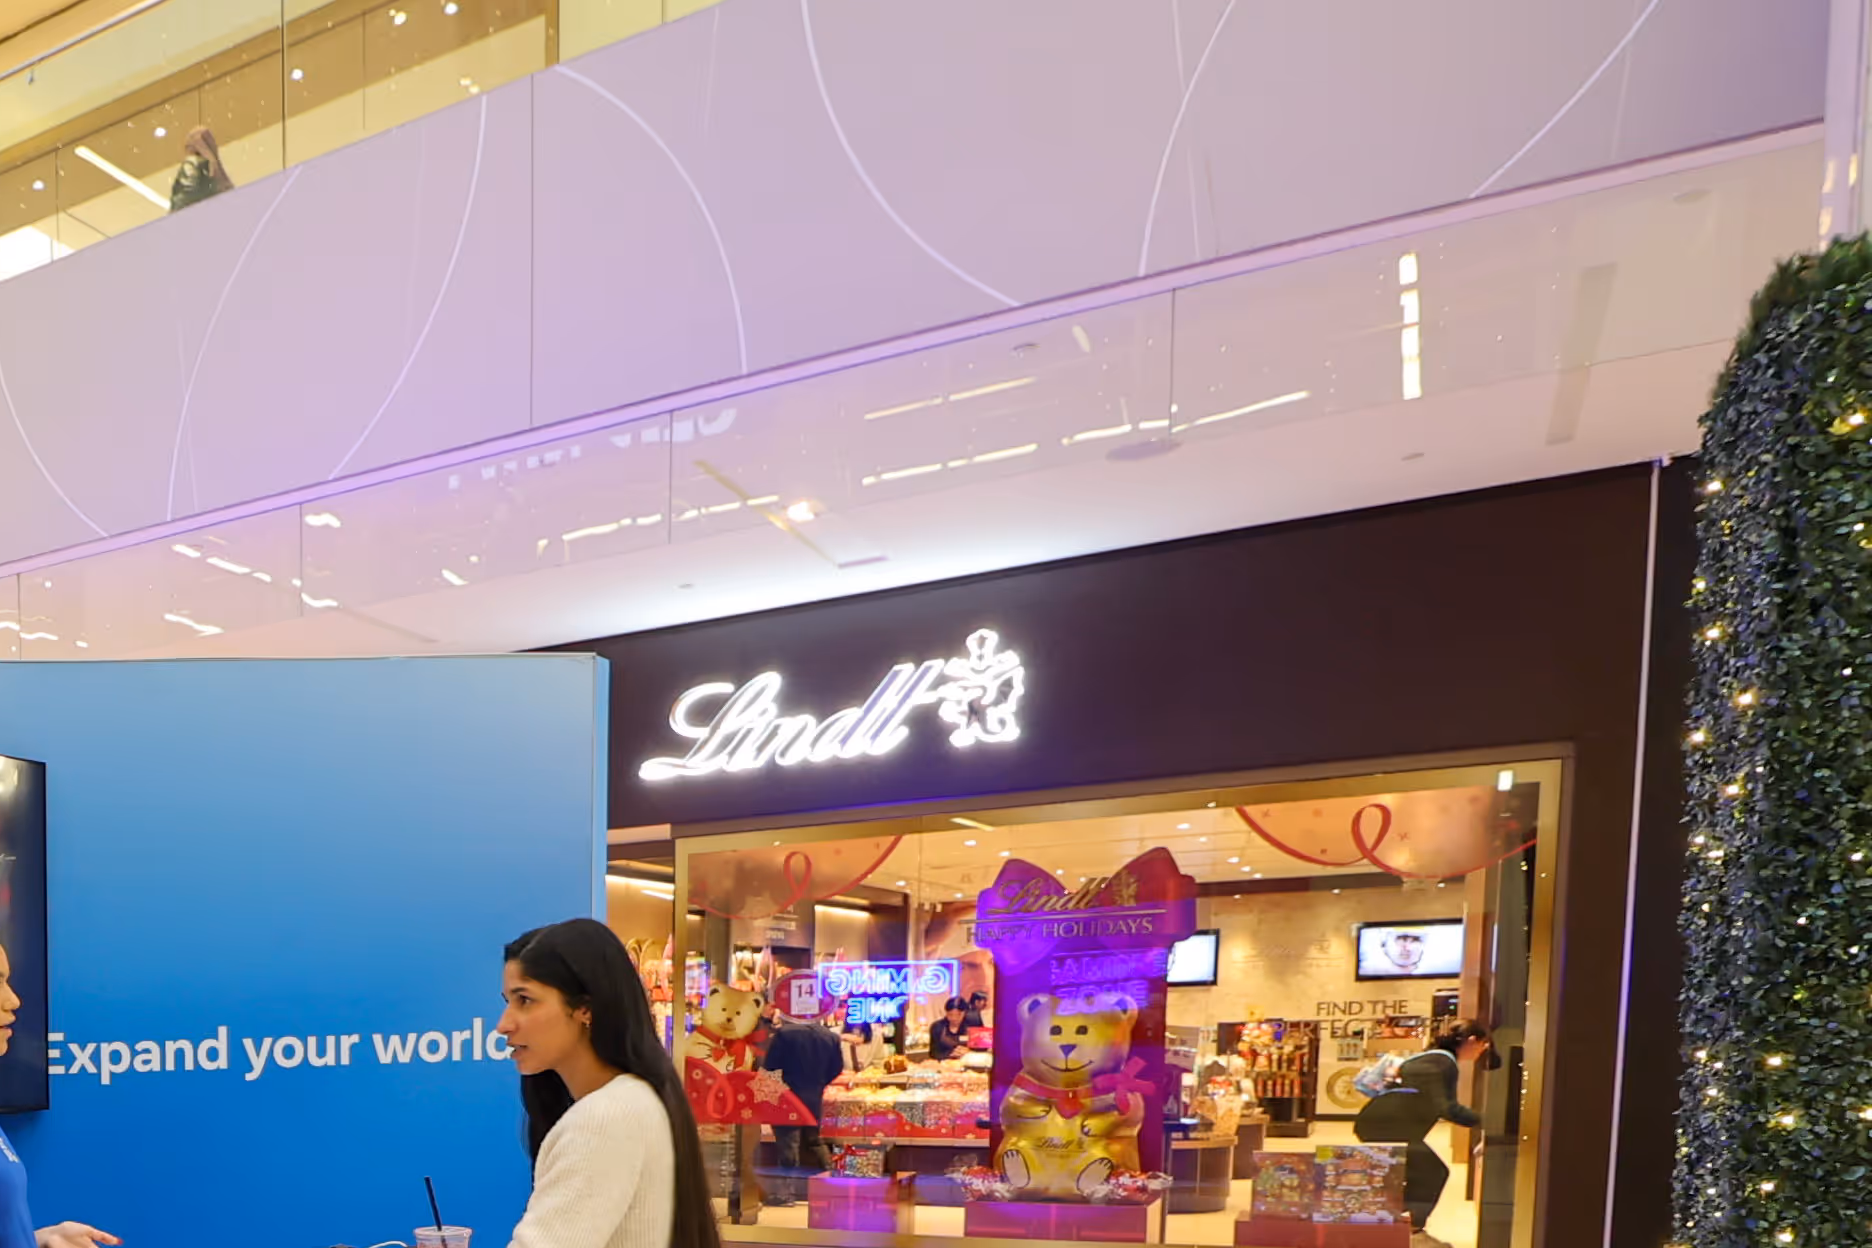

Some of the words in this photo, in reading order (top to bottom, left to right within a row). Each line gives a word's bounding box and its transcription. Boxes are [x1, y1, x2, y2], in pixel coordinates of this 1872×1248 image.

[639, 659, 950, 780] Lindt
[986, 876, 1111, 914] Lindt
[966, 925, 1033, 944] HAPPY
[1042, 917, 1153, 938] HOLIDAYS
[1316, 1001, 1364, 1016] FIND
[1367, 1000, 1408, 1015] THE
[48, 1026, 228, 1085] Expand
[243, 1031, 361, 1081] your
